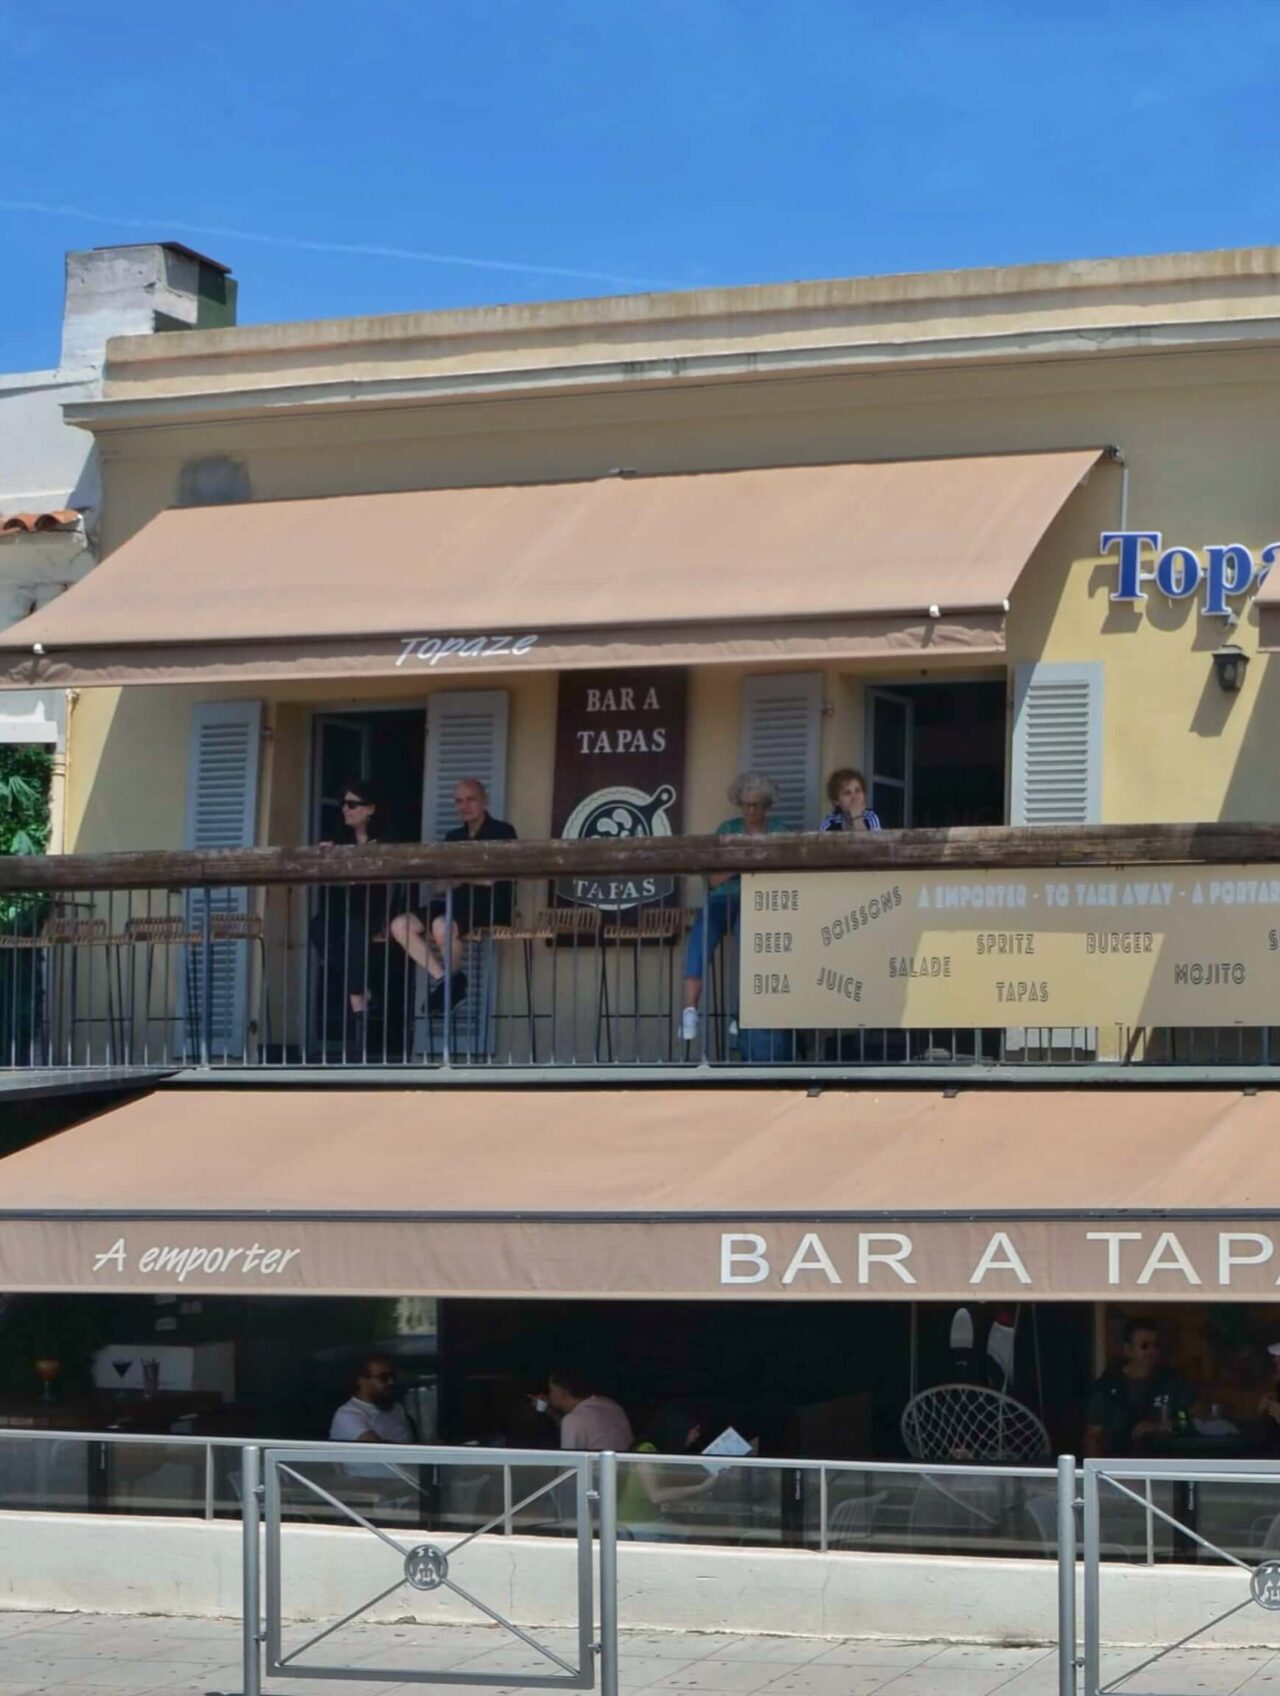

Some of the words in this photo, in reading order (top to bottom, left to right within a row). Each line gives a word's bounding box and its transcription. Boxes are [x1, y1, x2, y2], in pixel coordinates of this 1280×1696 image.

[395, 634, 538, 666] Topaze
[586, 688, 636, 712] BAR
[643, 687, 660, 710] A
[577, 728, 666, 754] TAPAS
[754, 890, 799, 911] BIERE
[935, 884, 1027, 908] EMPORTER
[1045, 884, 1069, 907] TO
[1075, 883, 1117, 906] TAKE
[1122, 881, 1174, 905] AWAY
[821, 886, 903, 947] BOISSONS
[754, 932, 793, 953] BEER
[976, 933, 1034, 954] SPRITZ
[1087, 932, 1154, 954] BURGER
[889, 957, 951, 978] SALADE
[1174, 963, 1246, 985] MOJITO
[754, 974, 791, 995] BIRA
[817, 967, 863, 1002] JUICE
[996, 981, 1048, 1002] TAPAS
[92, 1237, 127, 1272] A
[139, 1242, 300, 1282] emporter
[720, 1233, 917, 1284] BAR
[970, 1232, 1032, 1284] A
